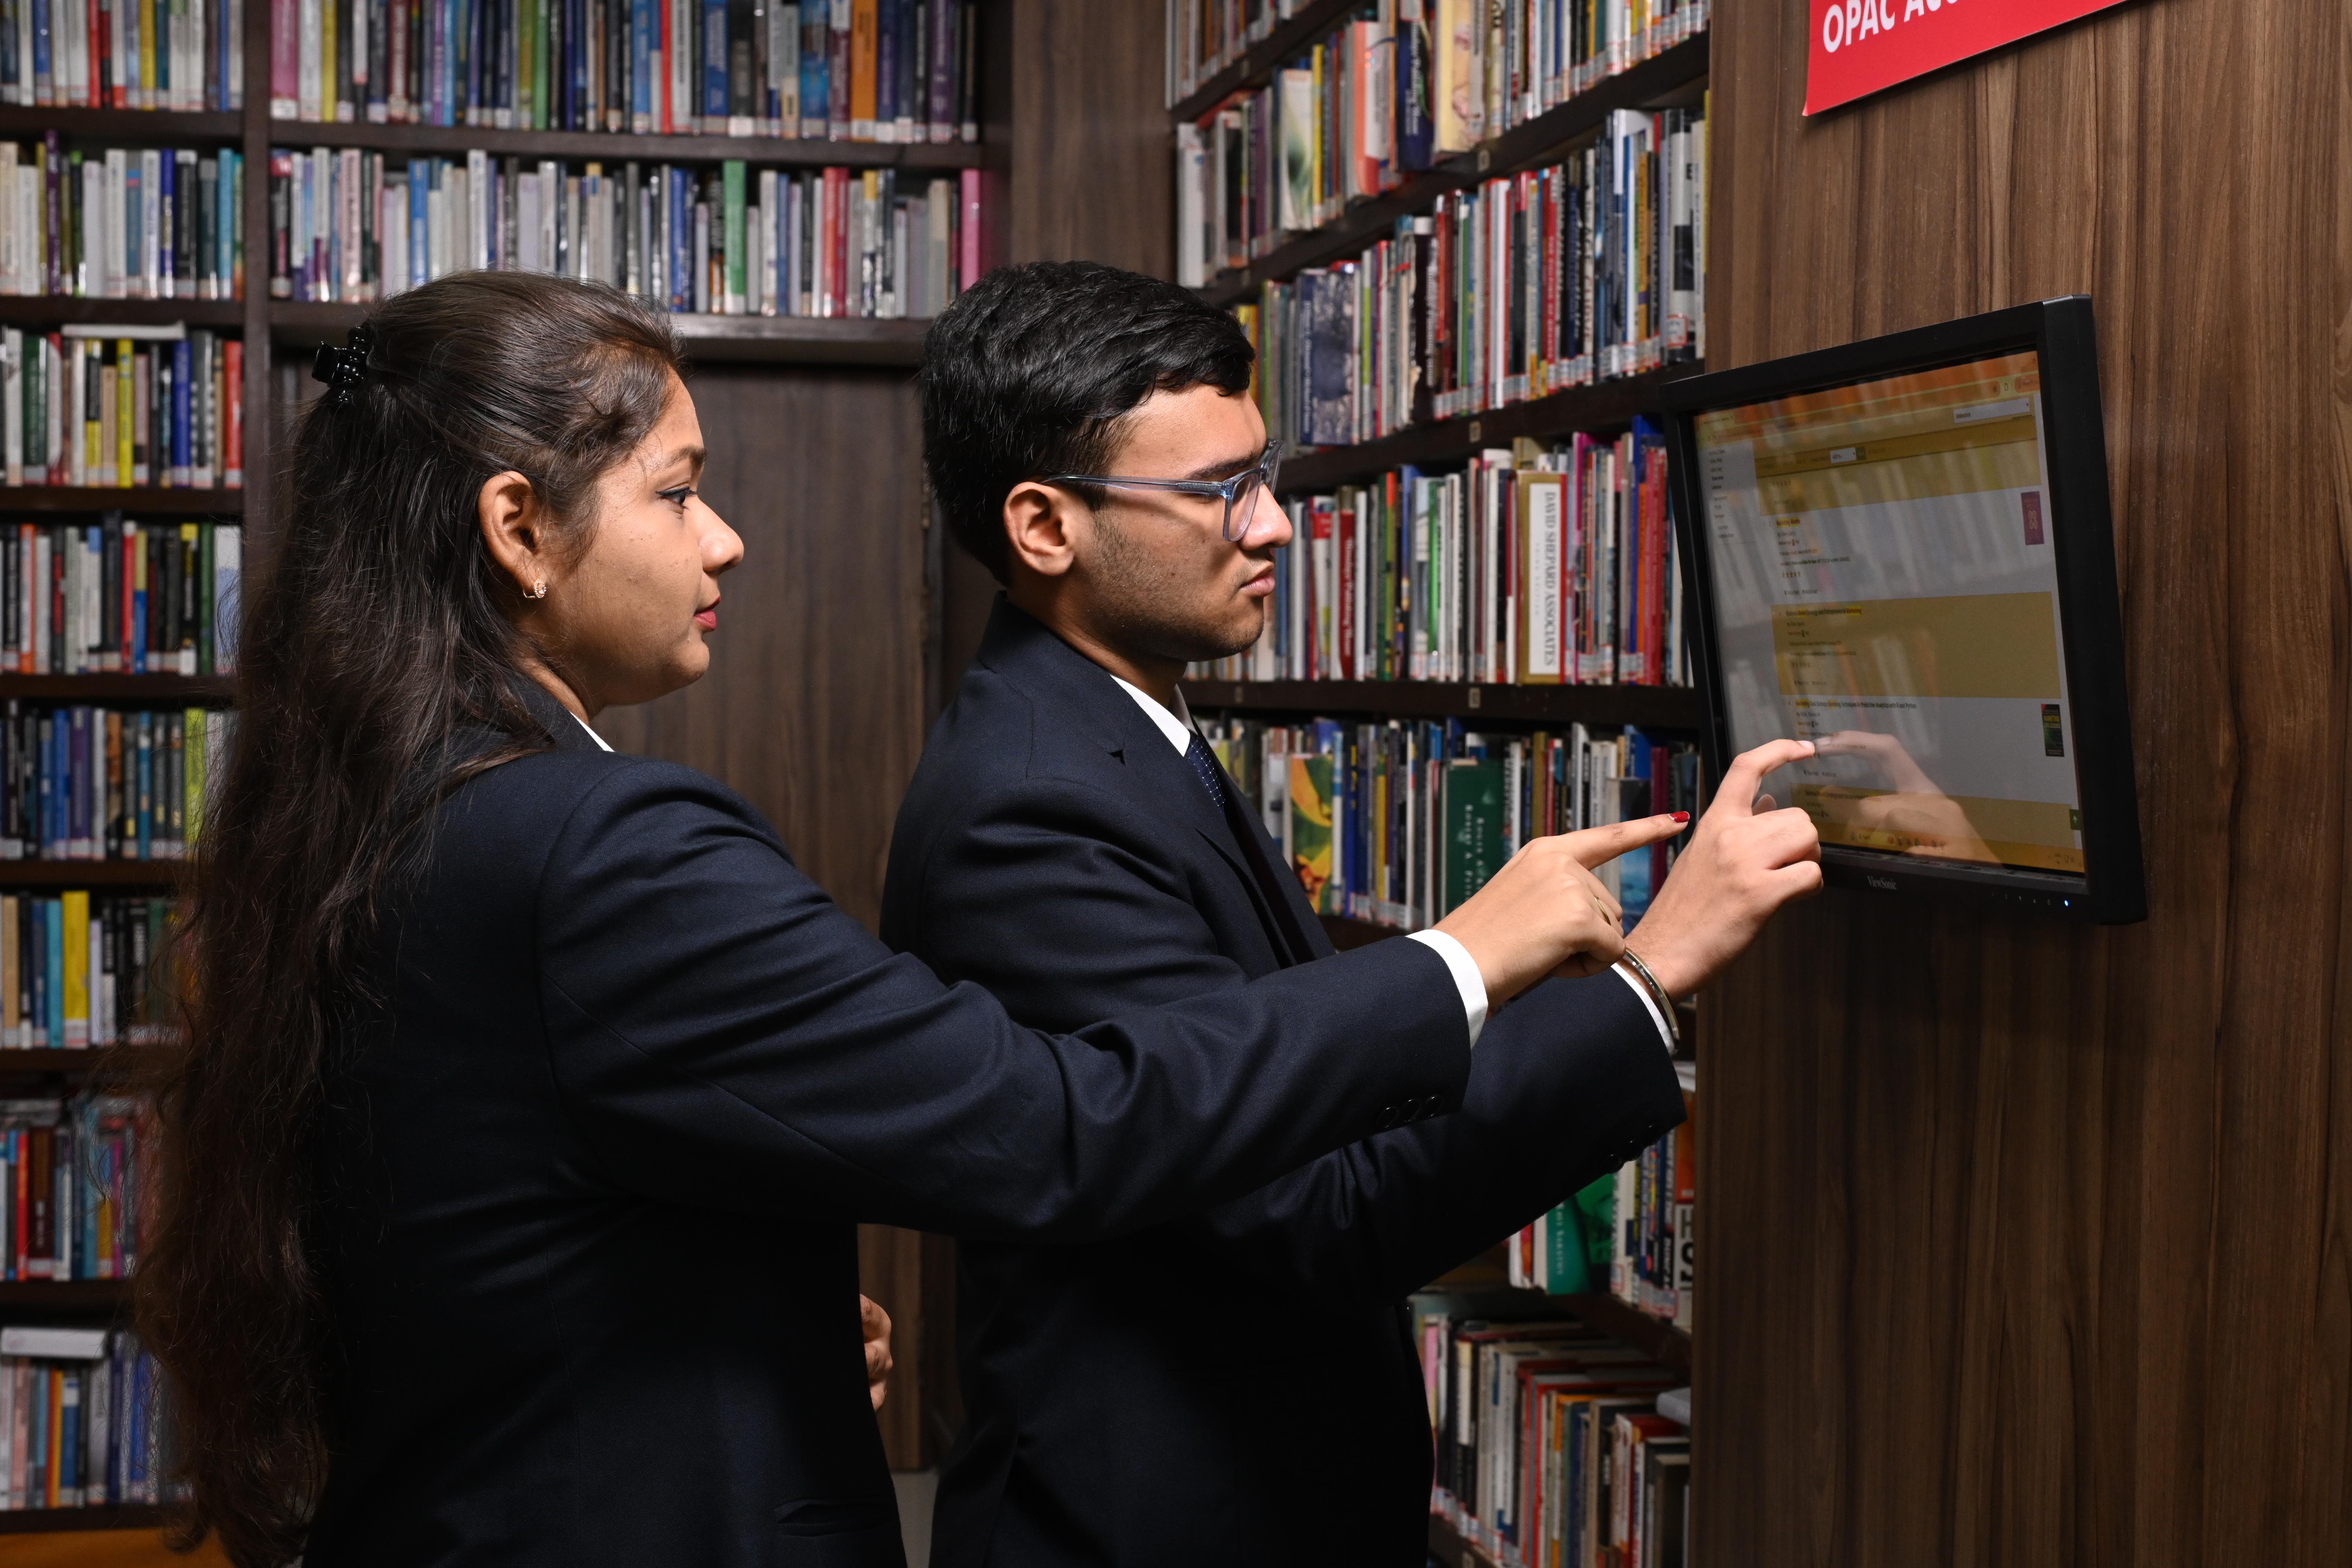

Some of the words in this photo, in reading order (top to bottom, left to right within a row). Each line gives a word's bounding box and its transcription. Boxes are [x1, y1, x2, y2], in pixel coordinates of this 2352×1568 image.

[1823, 0, 1895, 52] OPAC
[1544, 492, 1557, 529] DAVID
[1544, 531, 1557, 589] SHEPARD
[1544, 593, 1557, 666] ASSOCIATES
[1867, 875, 1897, 890] ViewSonic
